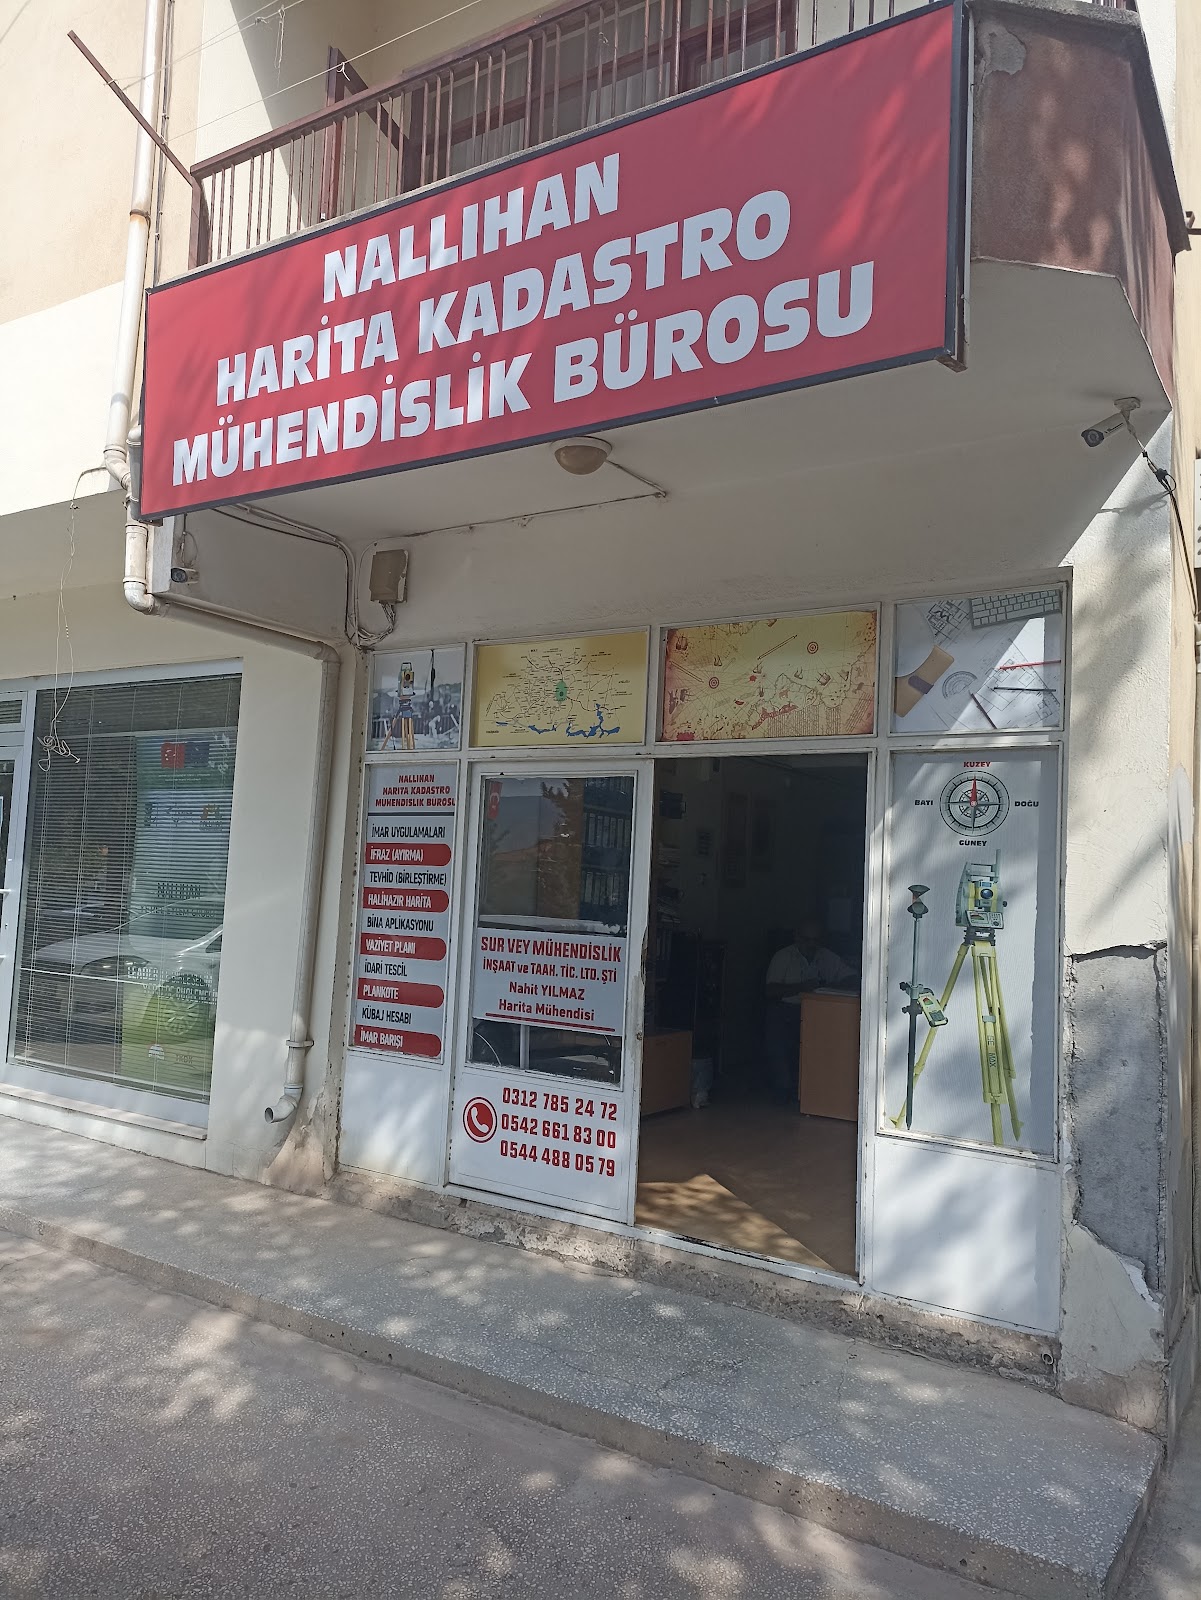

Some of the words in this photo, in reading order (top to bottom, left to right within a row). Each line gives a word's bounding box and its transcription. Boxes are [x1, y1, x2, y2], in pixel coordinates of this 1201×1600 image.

[322, 153, 621, 304] NALLIHAN
[216, 314, 399, 407] HARİTA
[418, 190, 792, 354] KADASTRO
[172, 352, 533, 487] MÜHENDİSLİK
[552, 261, 876, 404] BÜROSU
[399, 774, 435, 783] NALLIHAN
[411, 786, 451, 795] KADASTRO
[1014, 799, 1040, 808] DOĞU
[371, 823, 389, 838] İMAR
[391, 826, 446, 838] UYGULAMALARI
[959, 838, 988, 847] GÜNEY
[370, 845, 391, 861] İFRAZ
[392, 848, 424, 862] (AYIRMA)
[369, 868, 394, 883] TEVHİD
[395, 868, 447, 887] (BİRLEŞTİRME)
[367, 891, 404, 907] HALİHAZIR
[405, 893, 432, 909] HARİTA
[366, 913, 384, 929] BİNA
[384, 915, 434, 932] APLİKASYONU
[365, 937, 394, 953] VAZİYET
[394, 941, 416, 955] PLANI
[481, 936, 505, 952] SUR
[507, 938, 530, 955] VEY
[532, 938, 622, 963] MÜHENDİSLİK
[364, 959, 383, 975] İDARİ
[384, 962, 408, 977] TESCİL
[482, 956, 516, 974] İNŞAAT
[517, 965, 529, 974] ve
[531, 962, 559, 977] TAAH.
[560, 963, 578, 979] TİC.
[580, 967, 600, 981] LTD.
[601, 967, 617, 984] ŞTİ
[362, 985, 399, 1000] PLANKOTE
[509, 981, 539, 996] Nahit
[541, 985, 585, 1001] YILMAZ
[361, 1005, 385, 1020] KÜBAJ
[385, 1010, 412, 1025] HESABI
[498, 999, 532, 1014] Harita
[535, 1002, 595, 1022] Mühendisi
[360, 1027, 379, 1044] İMAR
[379, 1033, 403, 1048] BARIŞI
[502, 1087, 537, 1107] 0312
[543, 1093, 569, 1112] 785
[574, 1098, 594, 1116] 24
[600, 1101, 617, 1119] 72
[501, 1113, 538, 1134] 0542
[542, 1120, 569, 1139] 661
[573, 1125, 591, 1143] 83
[596, 1129, 616, 1147] 00
[500, 1140, 537, 1161] 0544
[541, 1148, 570, 1167] 488
[575, 1153, 594, 1172] 05
[598, 1157, 615, 1176] 79
